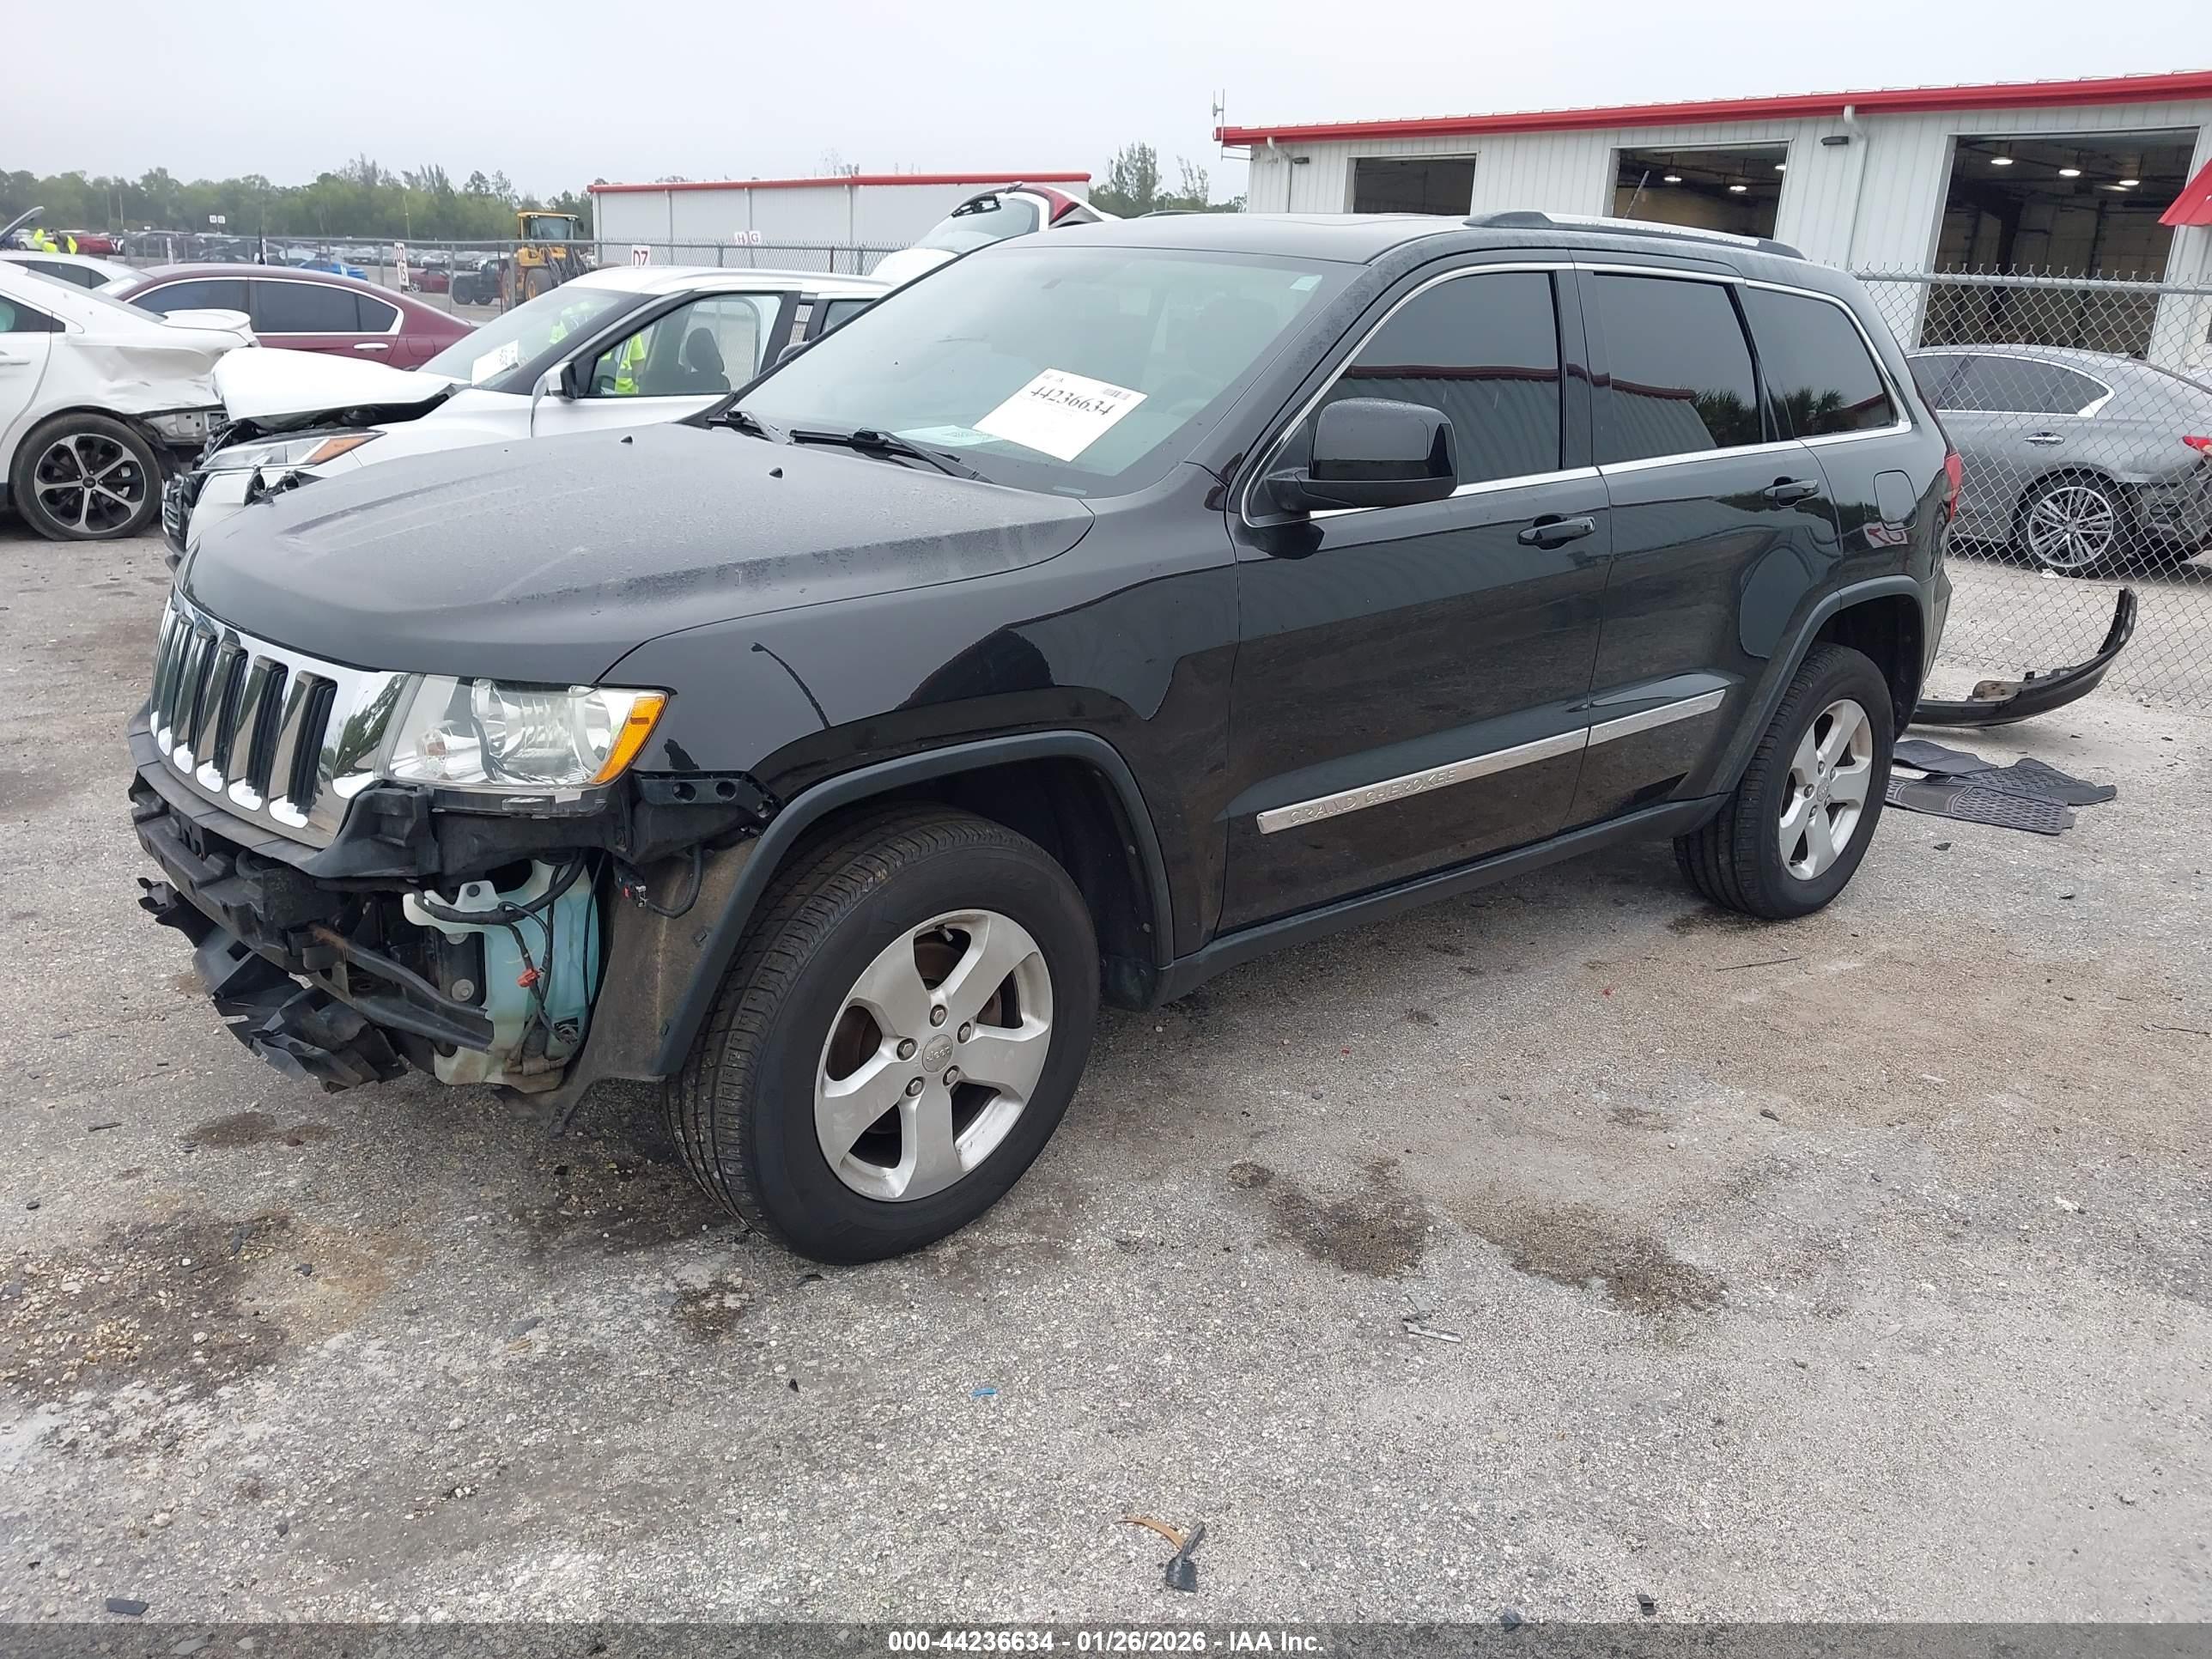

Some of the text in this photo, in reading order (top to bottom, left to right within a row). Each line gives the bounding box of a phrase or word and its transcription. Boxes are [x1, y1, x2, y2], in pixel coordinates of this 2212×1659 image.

[1030, 386, 1115, 416] 44236634
[1291, 769, 1457, 824] GRAND CHEROKEE
[927, 1046, 950, 1062] Jeep
